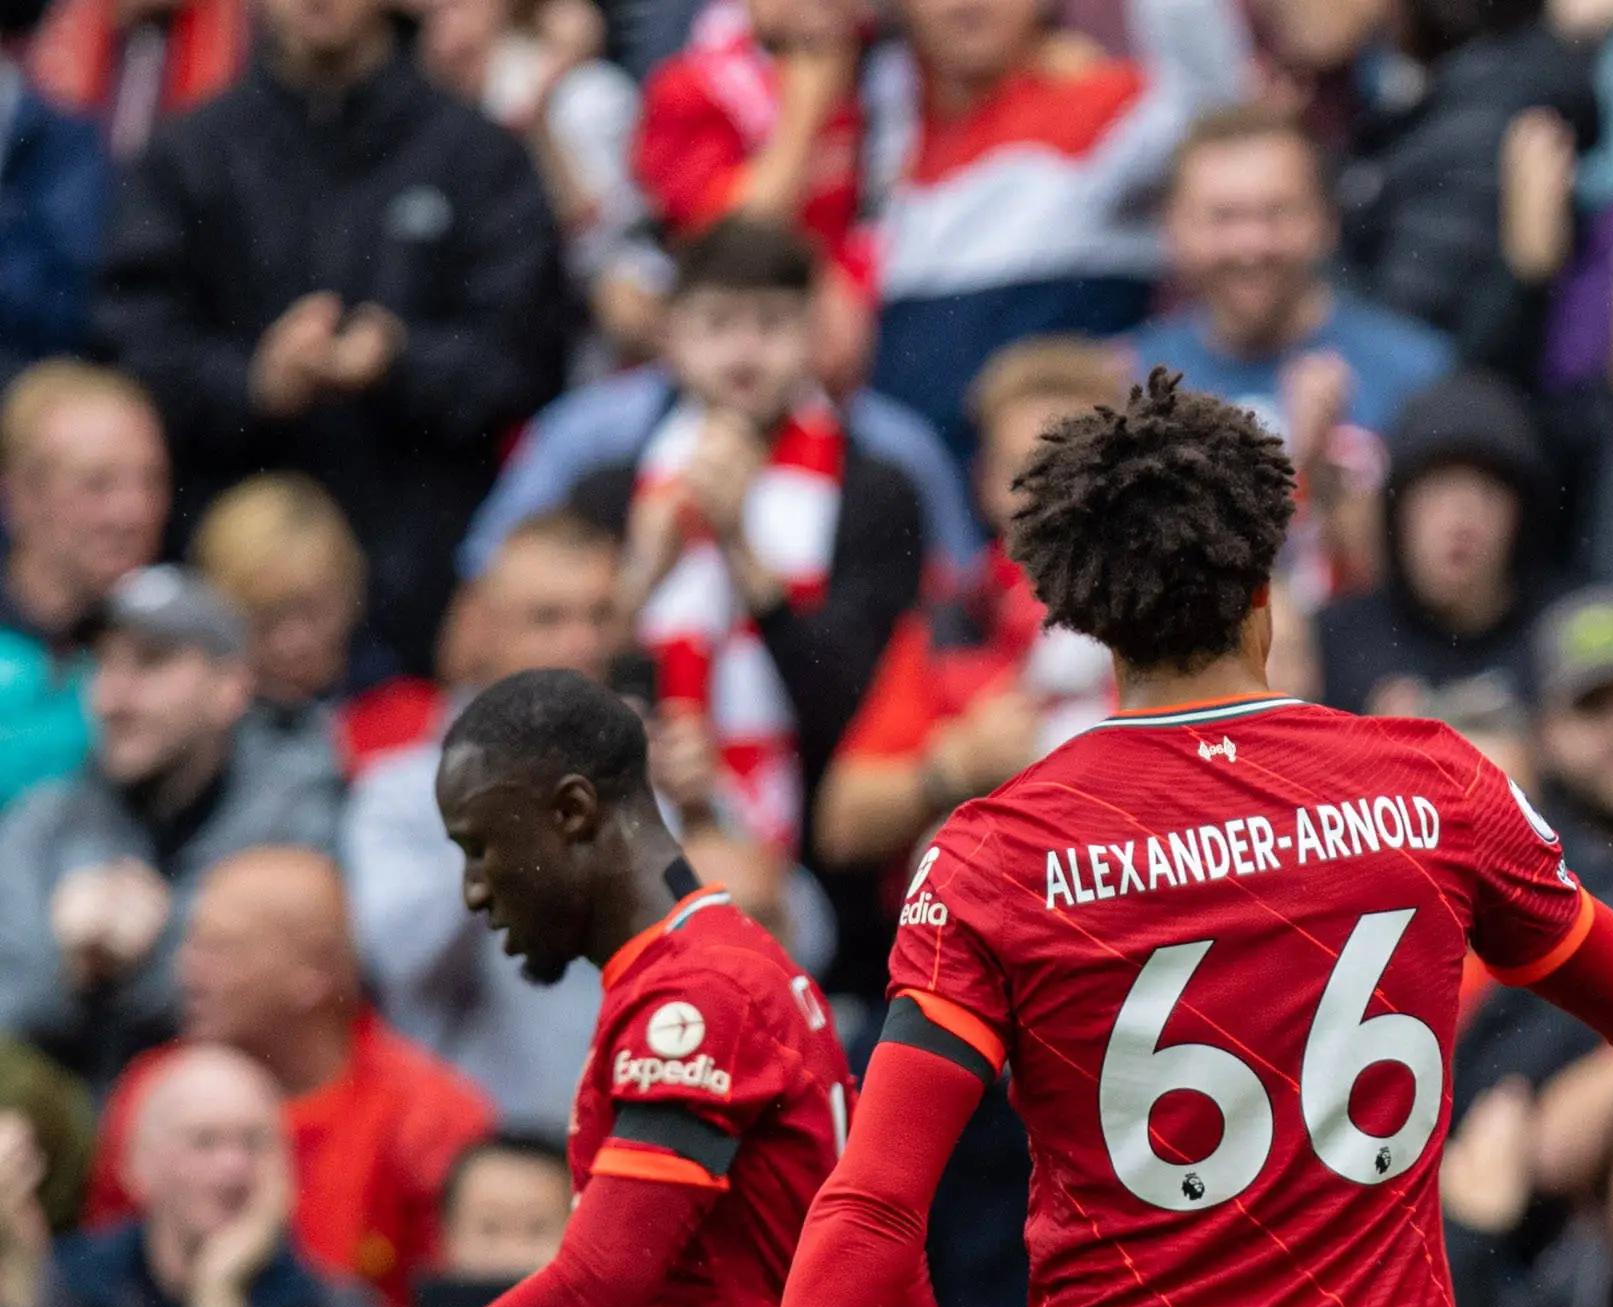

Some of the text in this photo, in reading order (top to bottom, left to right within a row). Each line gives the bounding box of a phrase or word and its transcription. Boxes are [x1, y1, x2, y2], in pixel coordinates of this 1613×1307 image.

[1044, 796, 1440, 909] ALEXANDER-ARNOLD
[612, 1050, 731, 1094] Expedia
[1100, 907, 1444, 1211] 66
